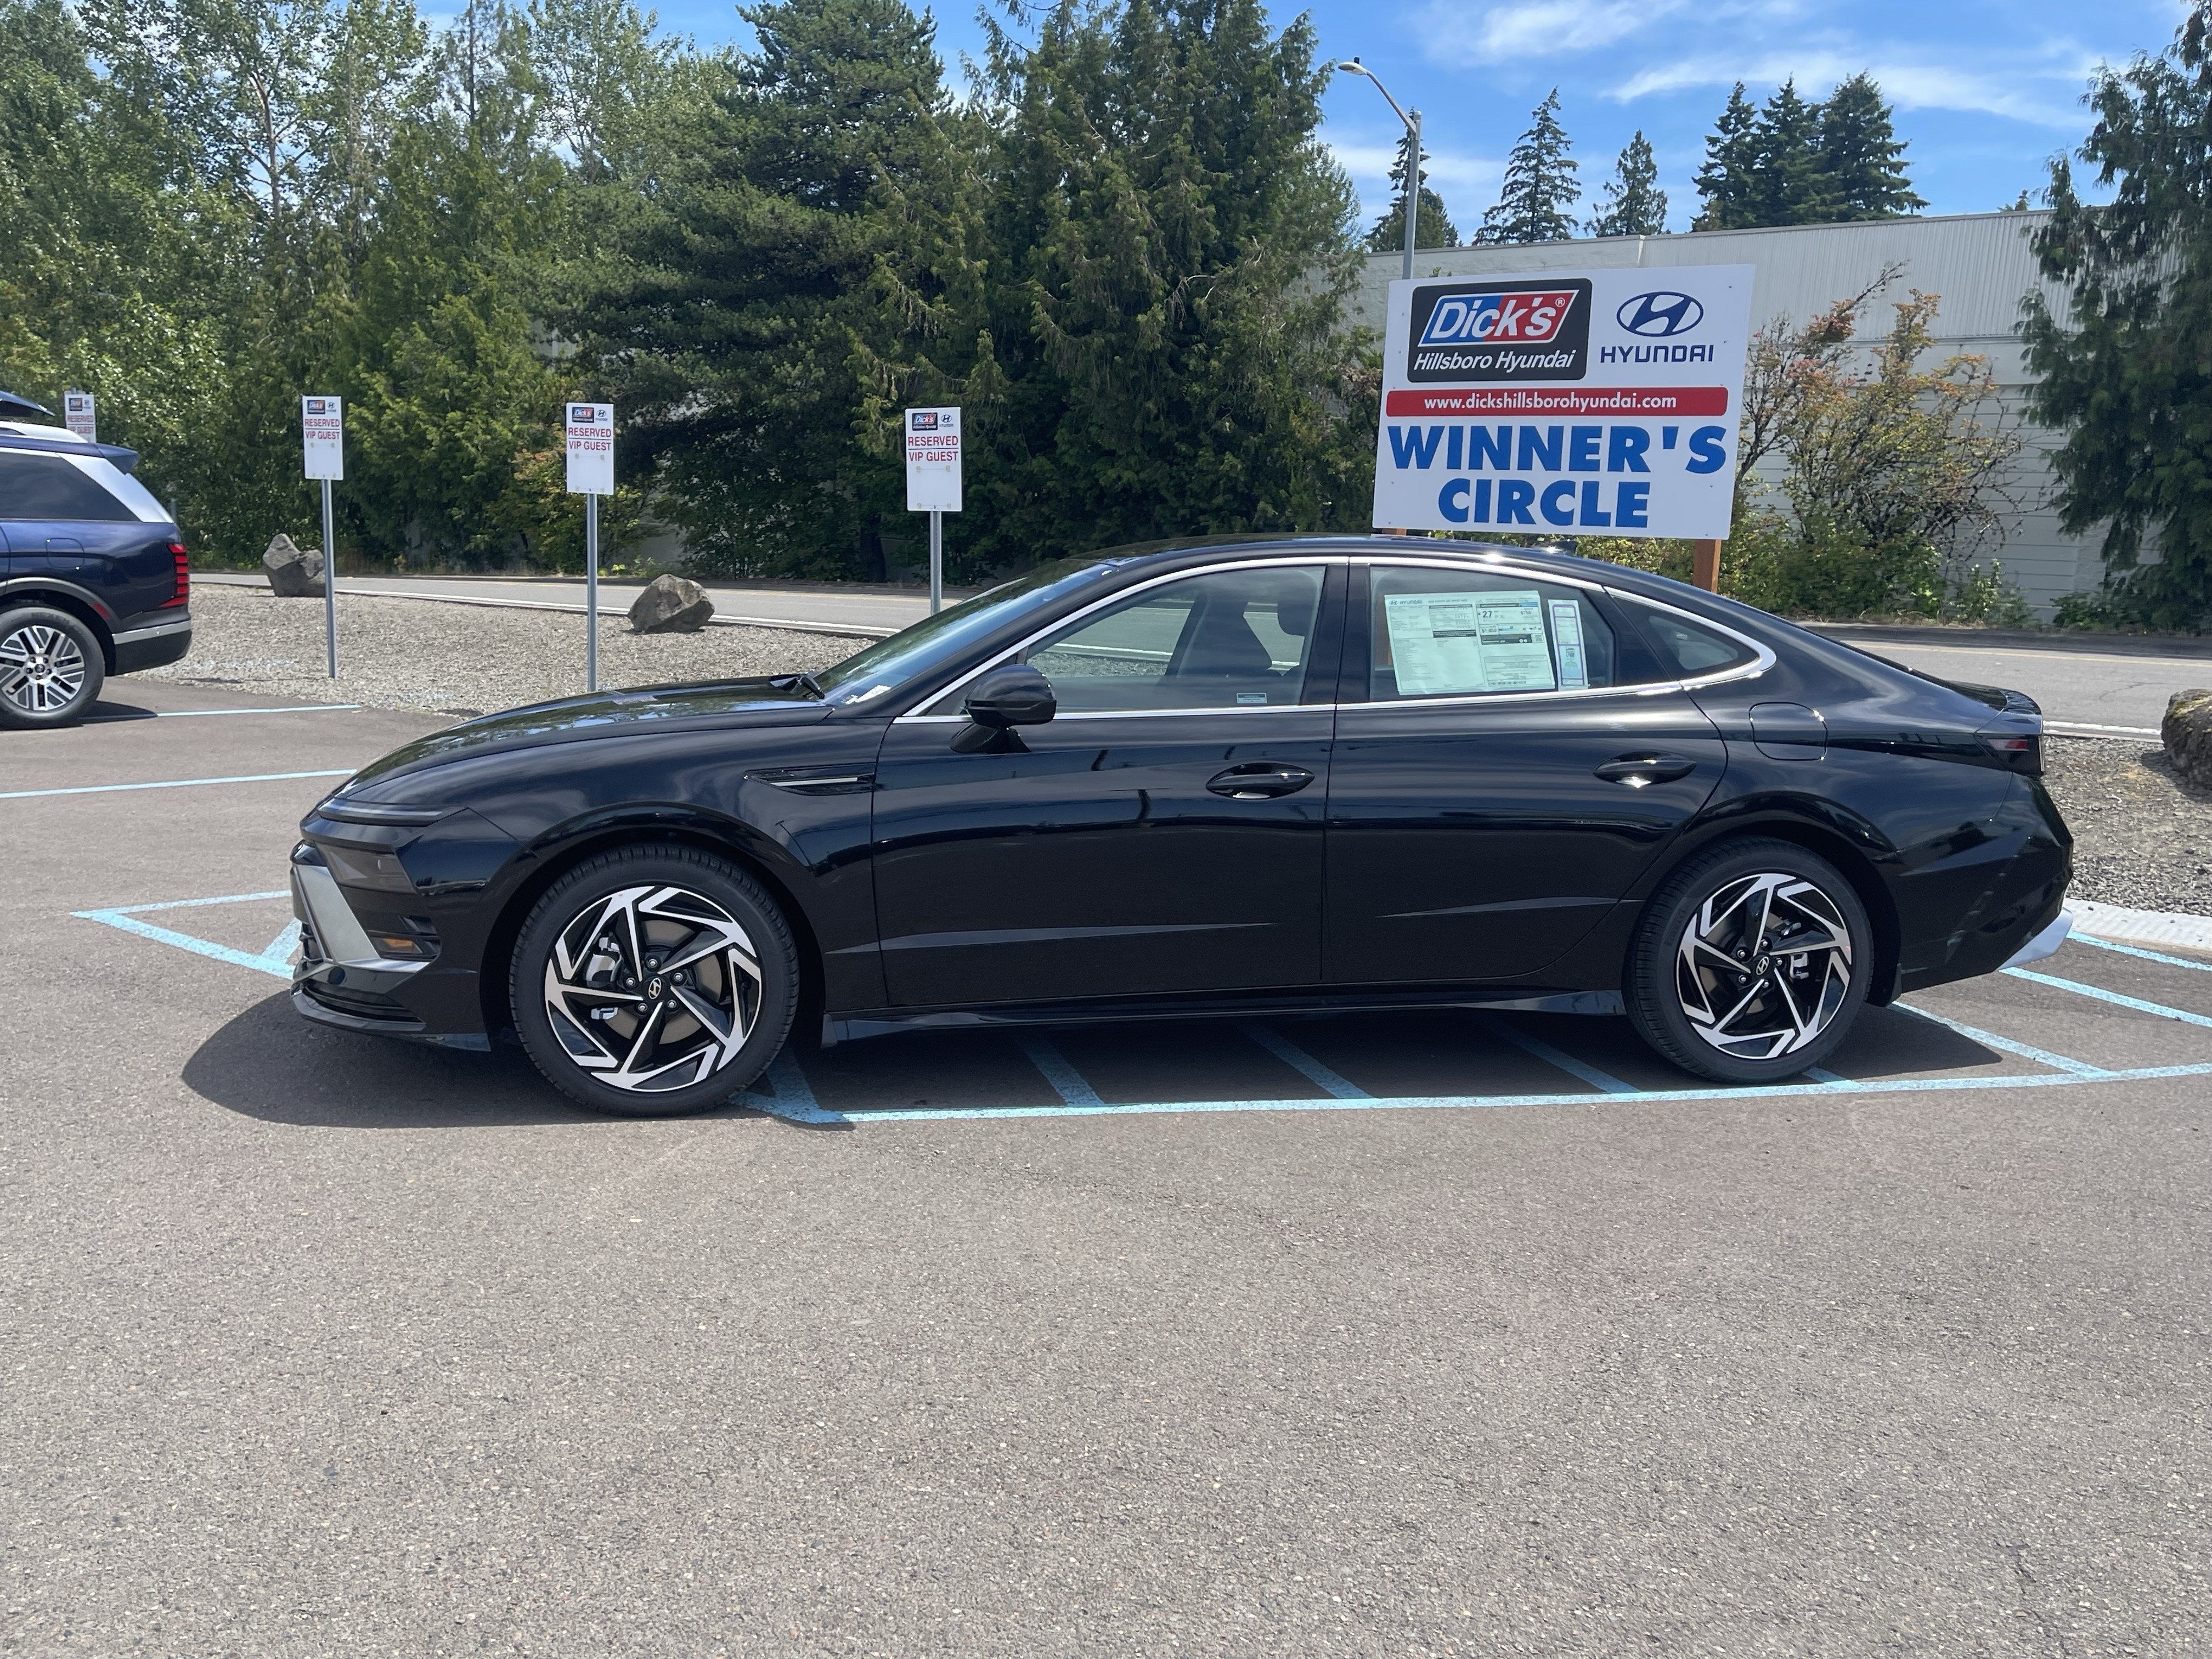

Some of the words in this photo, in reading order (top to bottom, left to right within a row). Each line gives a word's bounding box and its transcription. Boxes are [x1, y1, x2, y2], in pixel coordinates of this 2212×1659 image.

[1600, 344, 1714, 364] HYUNDAI
[1413, 352, 1493, 370] Hillsboro
[1495, 349, 1577, 373] Hyundai
[1424, 391, 1677, 413] www.dickshillsborohyundai.com
[304, 419, 340, 427] RESERVED
[305, 431, 315, 439] VIP
[318, 431, 340, 439] GUEST
[568, 427, 611, 438] RESERVED
[568, 441, 581, 449] VIP
[584, 441, 611, 450] GUEST
[908, 436, 958, 447] RESERVED
[1387, 425, 1726, 474] WINNER'S
[909, 452, 923, 461] VIP
[926, 451, 958, 461] GUEST
[1438, 478, 1651, 528] CIRCLE
